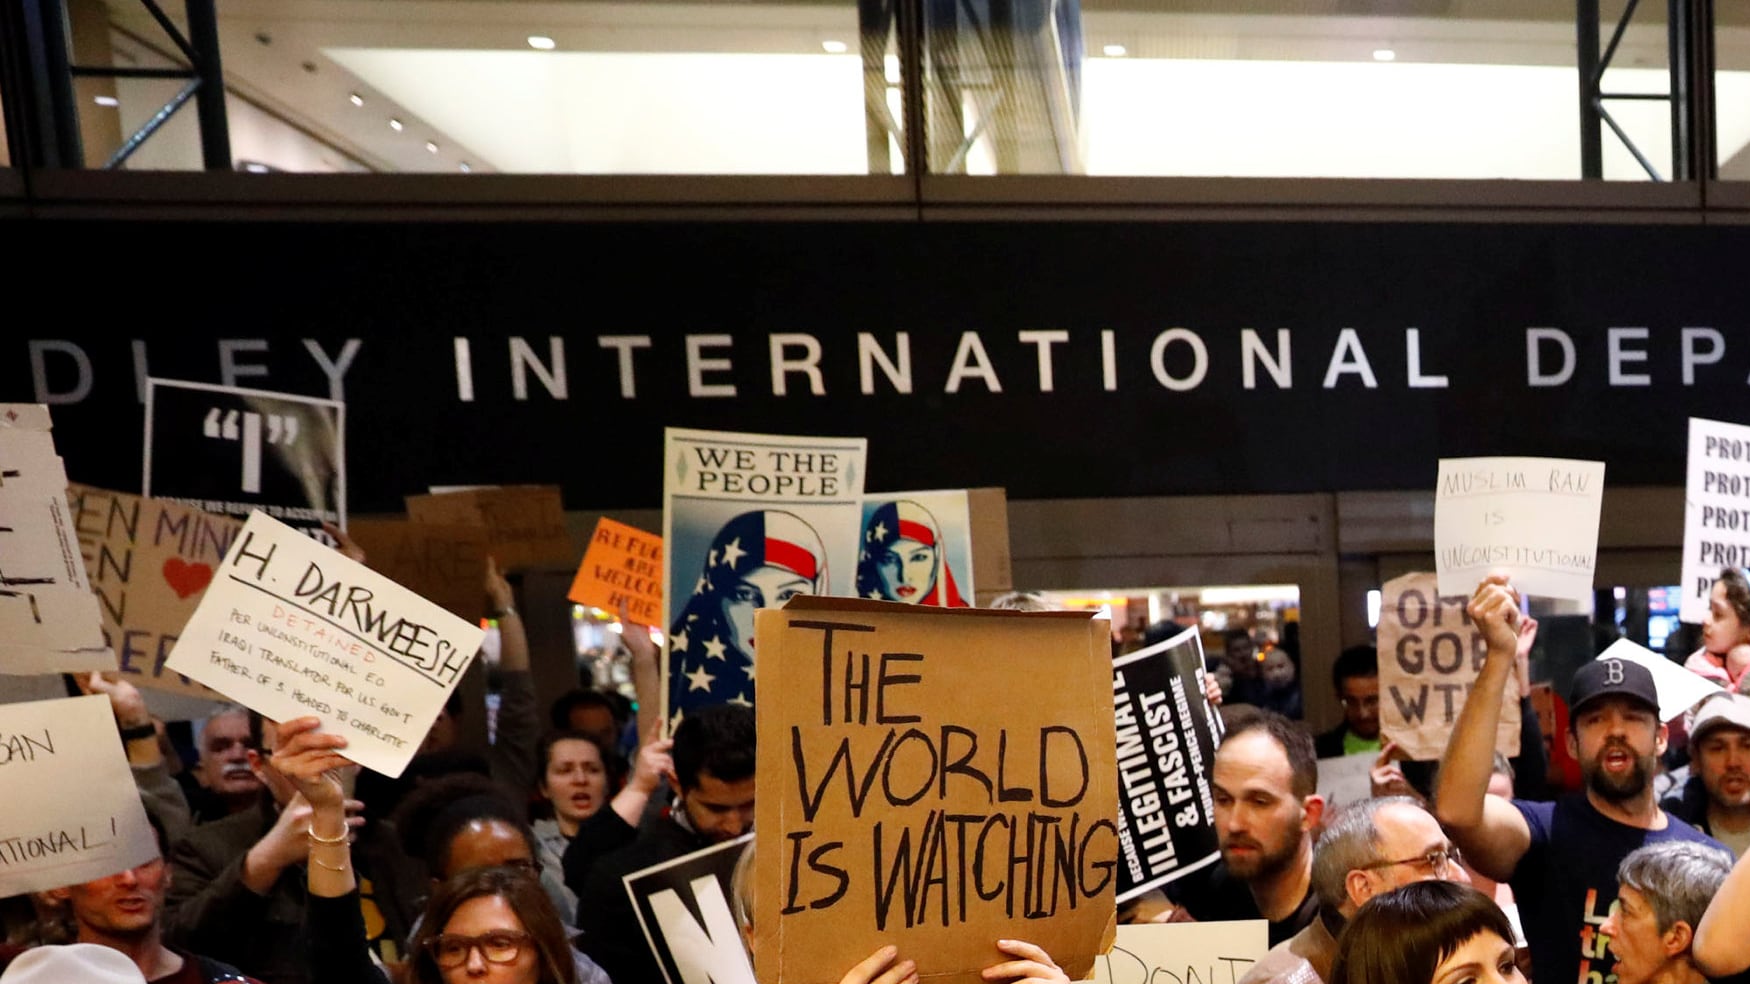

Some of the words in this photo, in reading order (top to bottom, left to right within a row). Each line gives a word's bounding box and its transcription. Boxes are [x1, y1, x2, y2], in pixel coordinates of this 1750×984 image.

[454, 328, 1449, 400] INTERNATIONAL
[695, 447, 756, 471] WE
[768, 451, 838, 474] THE
[696, 470, 839, 497] PEOPLE
[1442, 471, 1527, 495] MUSLIM
[233, 532, 277, 582] H.
[294, 561, 469, 684] DARWEESH
[272, 604, 376, 664] DETAINED
[1397, 588, 1473, 629] OM
[788, 618, 926, 728] THE
[1388, 683, 1474, 725] WT
[790, 725, 1089, 823] WORLD
[1139, 690, 1193, 806] FASCIST
[0, 816, 119, 866] TIONAL!
[1174, 802, 1200, 828] &
[780, 829, 850, 915] IS
[872, 813, 1118, 932] WATCHING
